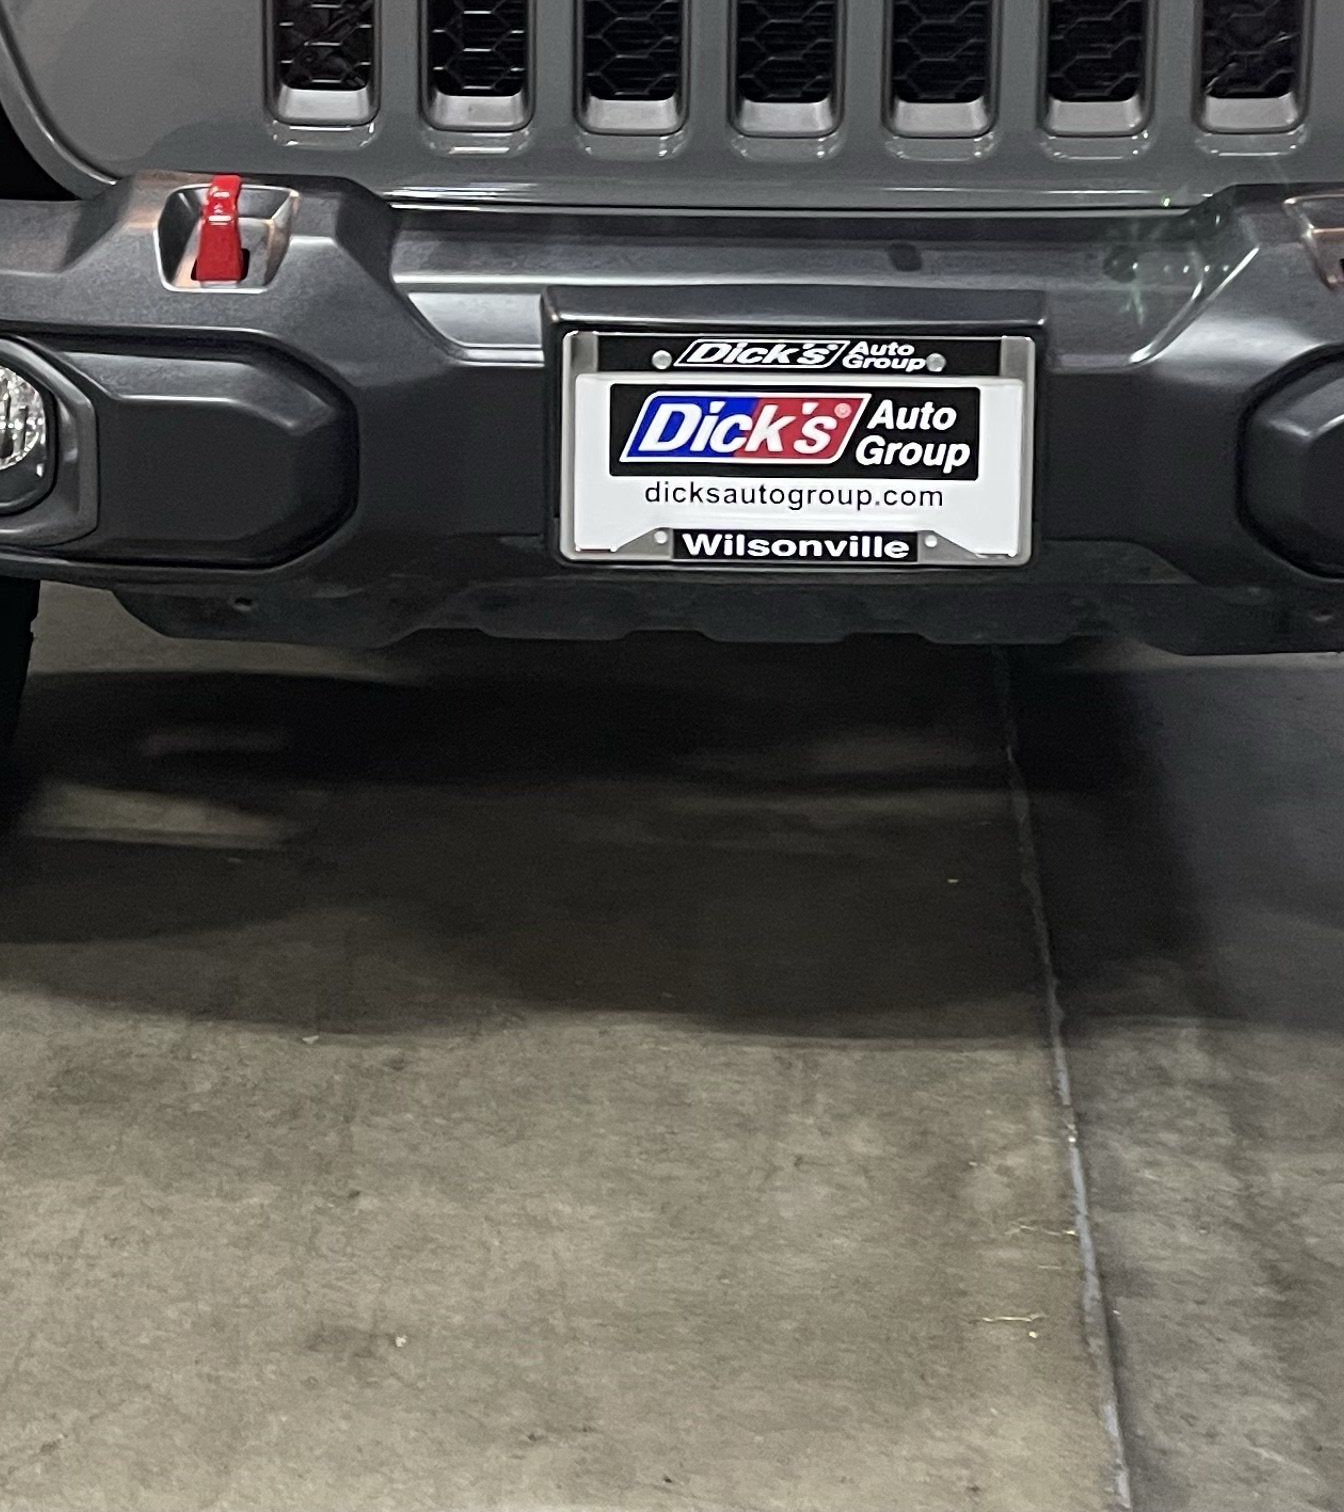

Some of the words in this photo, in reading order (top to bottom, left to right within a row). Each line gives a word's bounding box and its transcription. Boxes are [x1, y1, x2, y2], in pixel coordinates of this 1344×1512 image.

[842, 354, 926, 372] Group
[850, 341, 915, 356] Auto
[638, 401, 837, 455] Dick's
[867, 399, 957, 430] Auto
[856, 435, 970, 473] Group
[645, 481, 944, 511] dicksautogroup.com
[682, 533, 910, 559] Wilsonville
